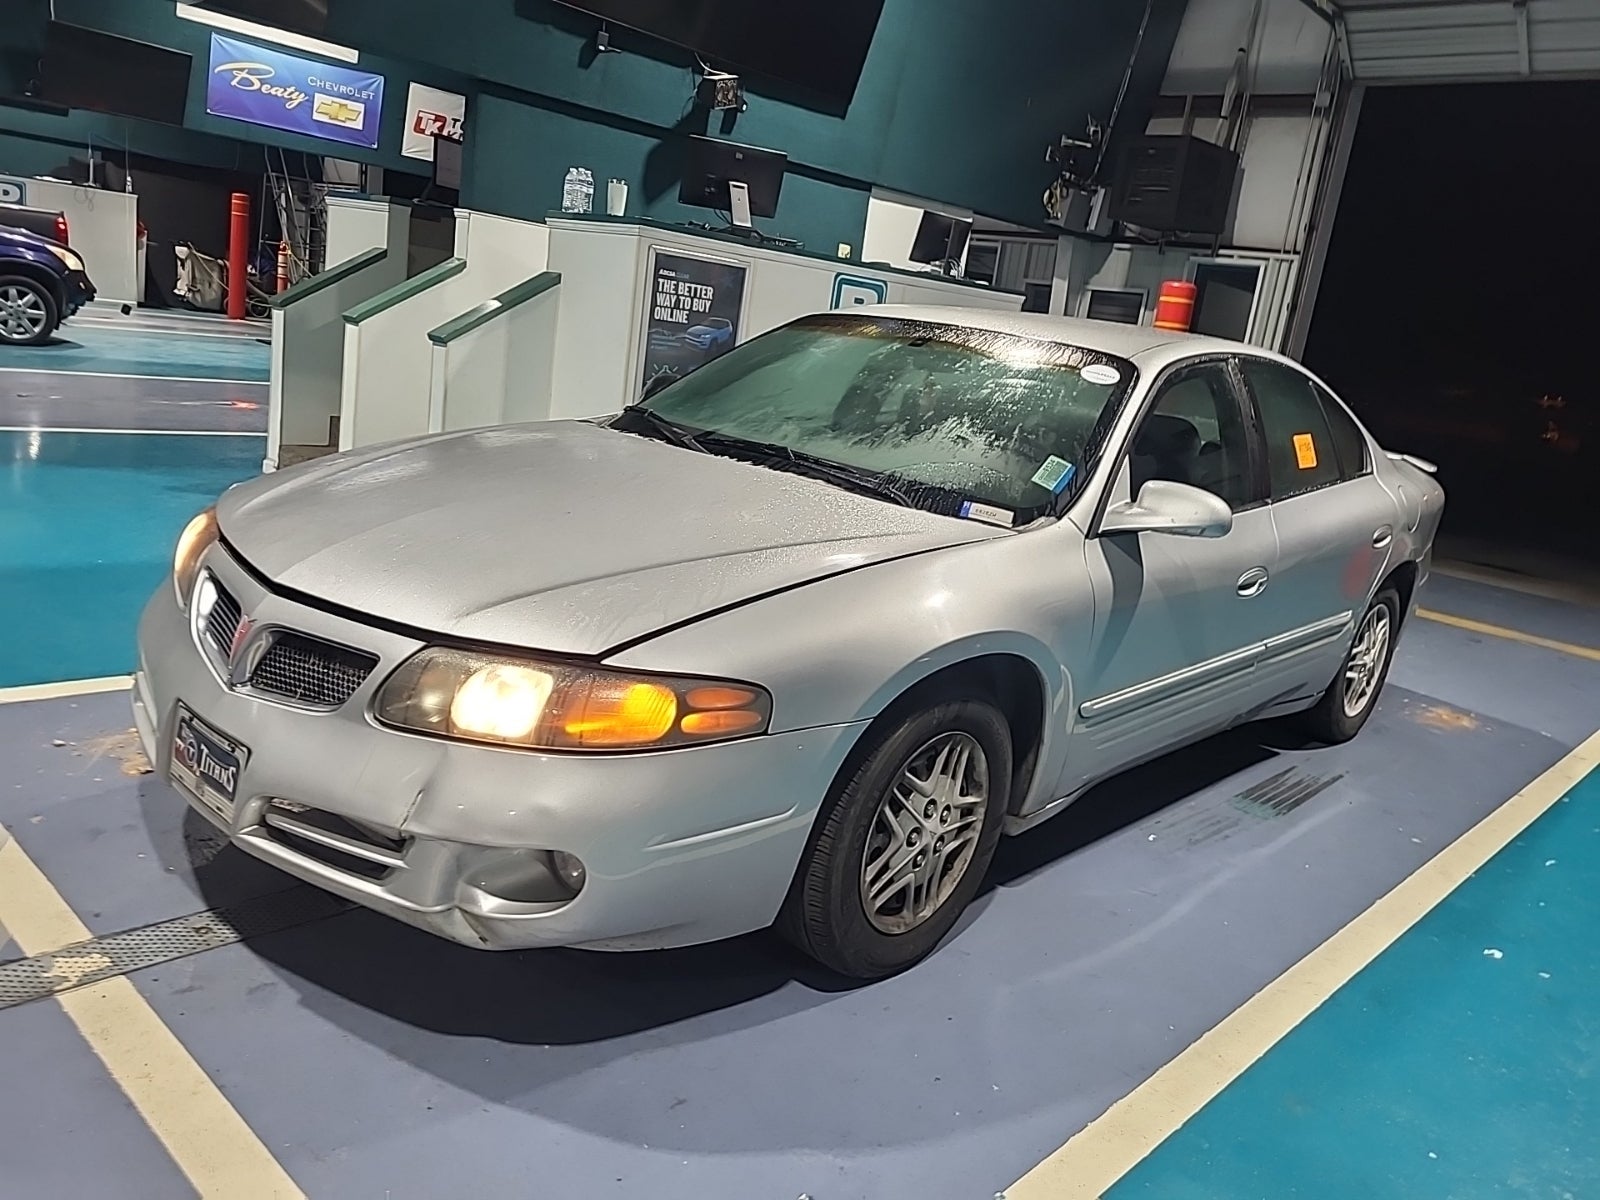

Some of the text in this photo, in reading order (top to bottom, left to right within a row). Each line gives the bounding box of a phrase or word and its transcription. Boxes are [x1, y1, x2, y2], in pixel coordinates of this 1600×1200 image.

[214, 61, 309, 110] Beaty
[308, 76, 375, 100] CHEVROLET
[418, 111, 444, 135] TK
[657, 278, 714, 300] THE BETTER
[656, 292, 712, 313] WAY TO BUY
[654, 306, 689, 324] ONLINE
